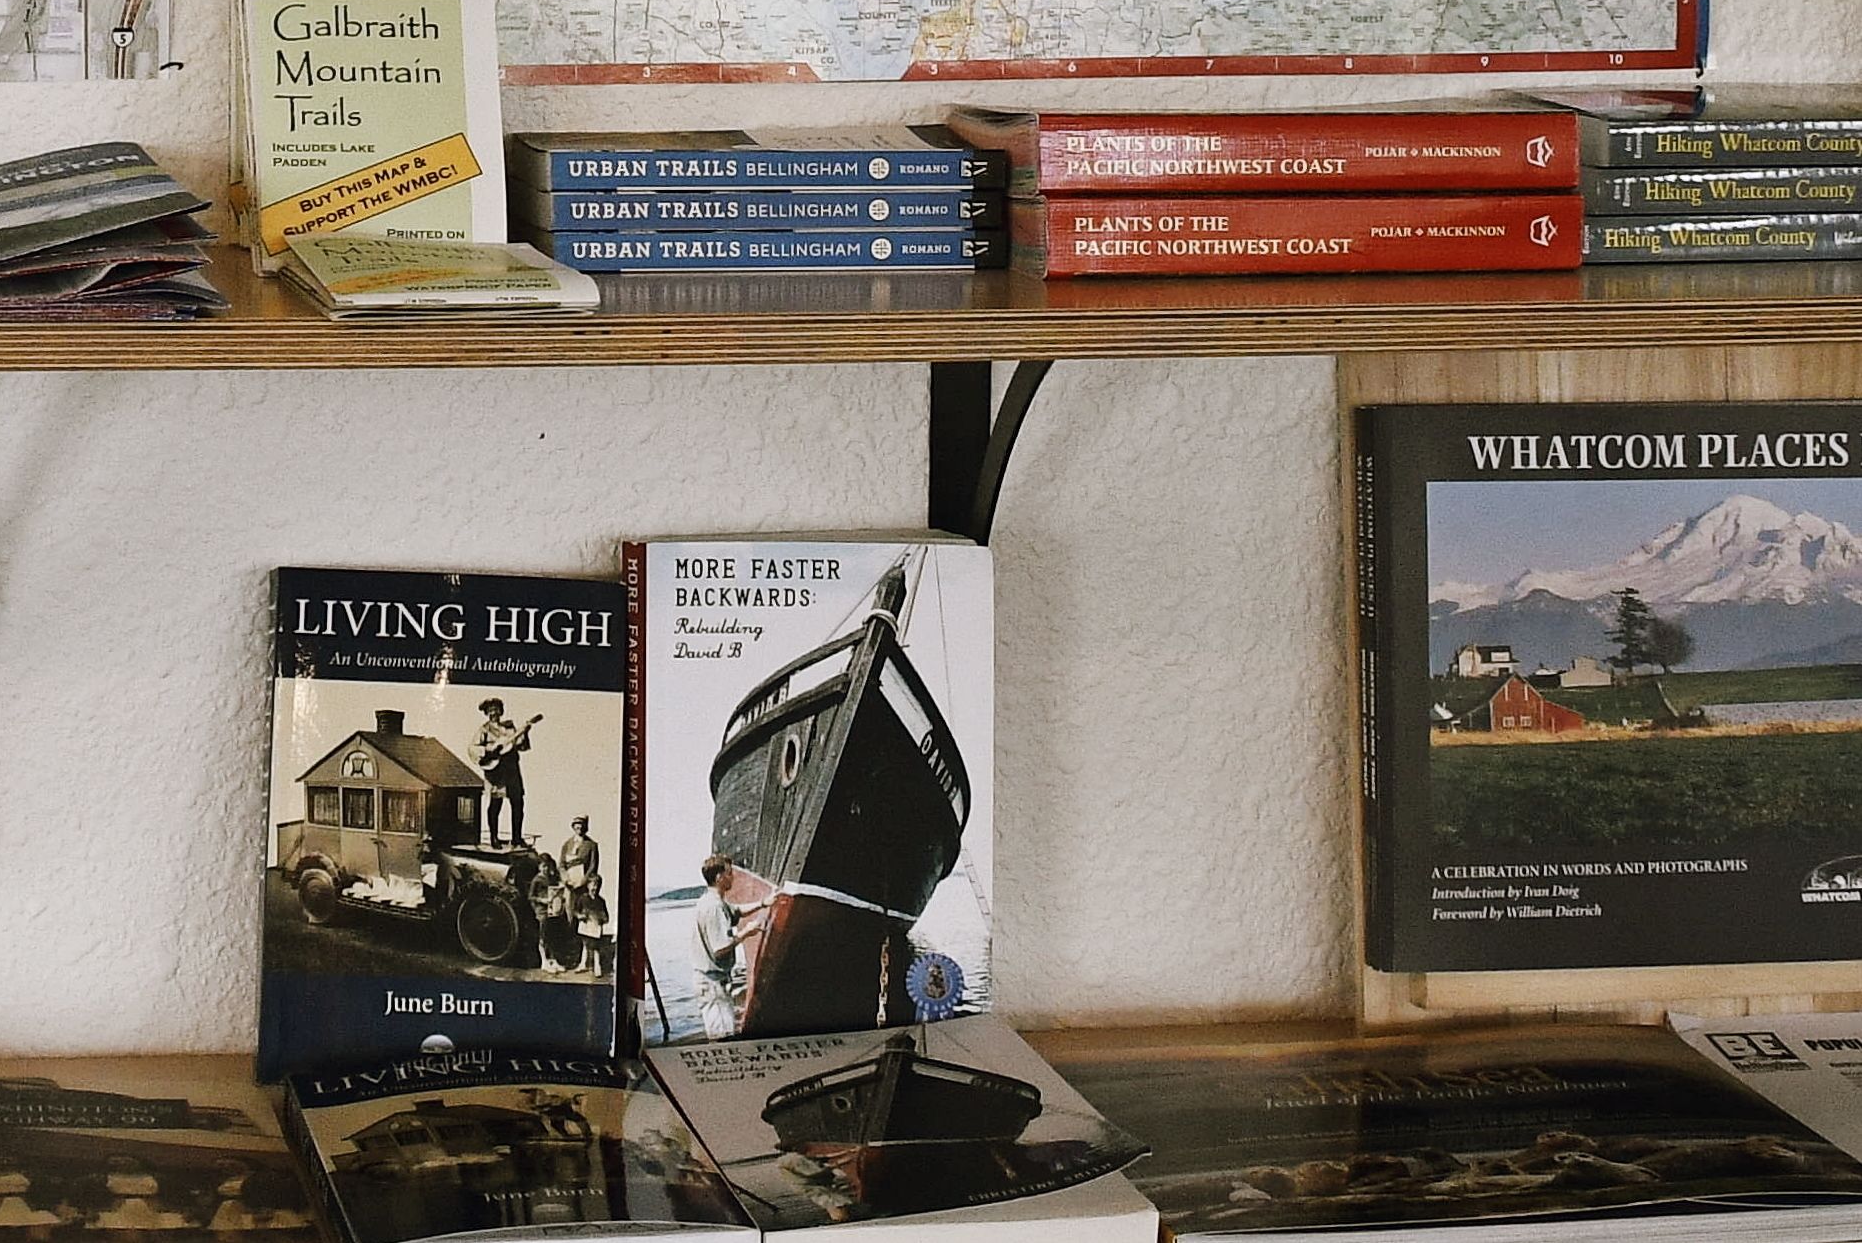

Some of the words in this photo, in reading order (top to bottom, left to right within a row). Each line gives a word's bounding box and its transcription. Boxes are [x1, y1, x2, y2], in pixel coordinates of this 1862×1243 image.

[273, 4, 439, 42] Galbraith
[276, 50, 441, 87] Mountain
[273, 95, 362, 132] Trails
[272, 142, 337, 154] INCLUDES
[340, 142, 375, 154] LAKE
[1066, 135, 1145, 153] PLANTS
[1151, 135, 1177, 153] OF
[1185, 135, 1222, 153] THE
[1365, 146, 1407, 158] POJAR
[1421, 146, 1501, 158] MACKINNON
[1656, 134, 1713, 158] Hiking
[1719, 132, 1802, 153] Whatcom
[1806, 132, 1862, 157] County
[273, 157, 327, 167] PADDEN
[568, 160, 648, 178] URBAN
[656, 159, 738, 178] TRAILS
[746, 161, 858, 177] BELLINGHAM
[899, 164, 950, 174] ROMANO
[1066, 158, 1145, 176] PACIFIC
[1149, 158, 1276, 176] NORTHWEST
[1280, 158, 1346, 175] COAST
[298, 191, 331, 213] BUY
[333, 177, 373, 199] THIS
[374, 163, 411, 186] MAP
[413, 157, 428, 169] &
[1644, 181, 1702, 206] Hiking
[1709, 180, 1790, 199] Whatcom
[1795, 179, 1856, 204] County
[283, 204, 356, 237] SUPPORT
[358, 190, 393, 212] THE
[393, 164, 459, 197] WMBC!
[570, 201, 649, 219] URBAN
[658, 200, 739, 219] TRAILS
[747, 203, 858, 218] BELLINGHAM
[899, 205, 949, 215] ROMANO
[386, 228, 443, 240] PRINTED
[446, 229, 466, 240] ON
[1074, 216, 1153, 234] PLANTS
[1158, 216, 1185, 233] OF
[1192, 216, 1229, 232] THE
[1371, 226, 1412, 238] POJAR
[1426, 225, 1505, 237] MACKINNON
[573, 241, 651, 258] URBAN
[660, 240, 740, 258] TRAILS
[749, 242, 861, 257] BELLINGHAM
[901, 244, 951, 254] ROMANO
[1074, 238, 1152, 256] PACIFIC
[1157, 238, 1283, 255] NORTHWEST
[1287, 238, 1352, 254] COAST
[1604, 228, 1661, 253] Hiking
[1669, 227, 1751, 246] Whatcom
[1755, 226, 1816, 251] County
[1468, 434, 1686, 470] WHATCOM
[1698, 432, 1849, 468] PLACES
[675, 558, 736, 579] MORE
[751, 558, 841, 580] FASTER
[627, 558, 638, 614] MORE
[676, 587, 817, 607] BACKWARDS:
[293, 598, 466, 641] LIVING
[485, 605, 614, 648] HIGH
[674, 617, 763, 641] Rebuilding
[673, 642, 723, 659] David
[727, 641, 743, 658] B
[329, 652, 352, 667] An
[356, 652, 468, 671] Unconventional
[471, 656, 577, 677] Autobiography
[628, 624, 639, 707] FASTER
[628, 716, 639, 848] BACKWARDS
[1431, 868, 1442, 880] A
[1443, 865, 1540, 880] CELEBRATION
[1543, 864, 1559, 878] IN
[1562, 863, 1612, 877] WORDS
[1614, 862, 1645, 875] AND
[1647, 859, 1749, 875] PHOTOGRAPHS
[1431, 886, 1505, 900] Introduction
[1507, 886, 1522, 900] by
[1524, 885, 1549, 898] Ivan
[1551, 884, 1580, 900] Doig
[1432, 906, 1487, 921] Foreword
[1489, 906, 1504, 921] by
[1506, 904, 1552, 919] William
[1555, 903, 1602, 918] Dietrich
[384, 990, 433, 1017] June
[441, 992, 495, 1016] Burn
